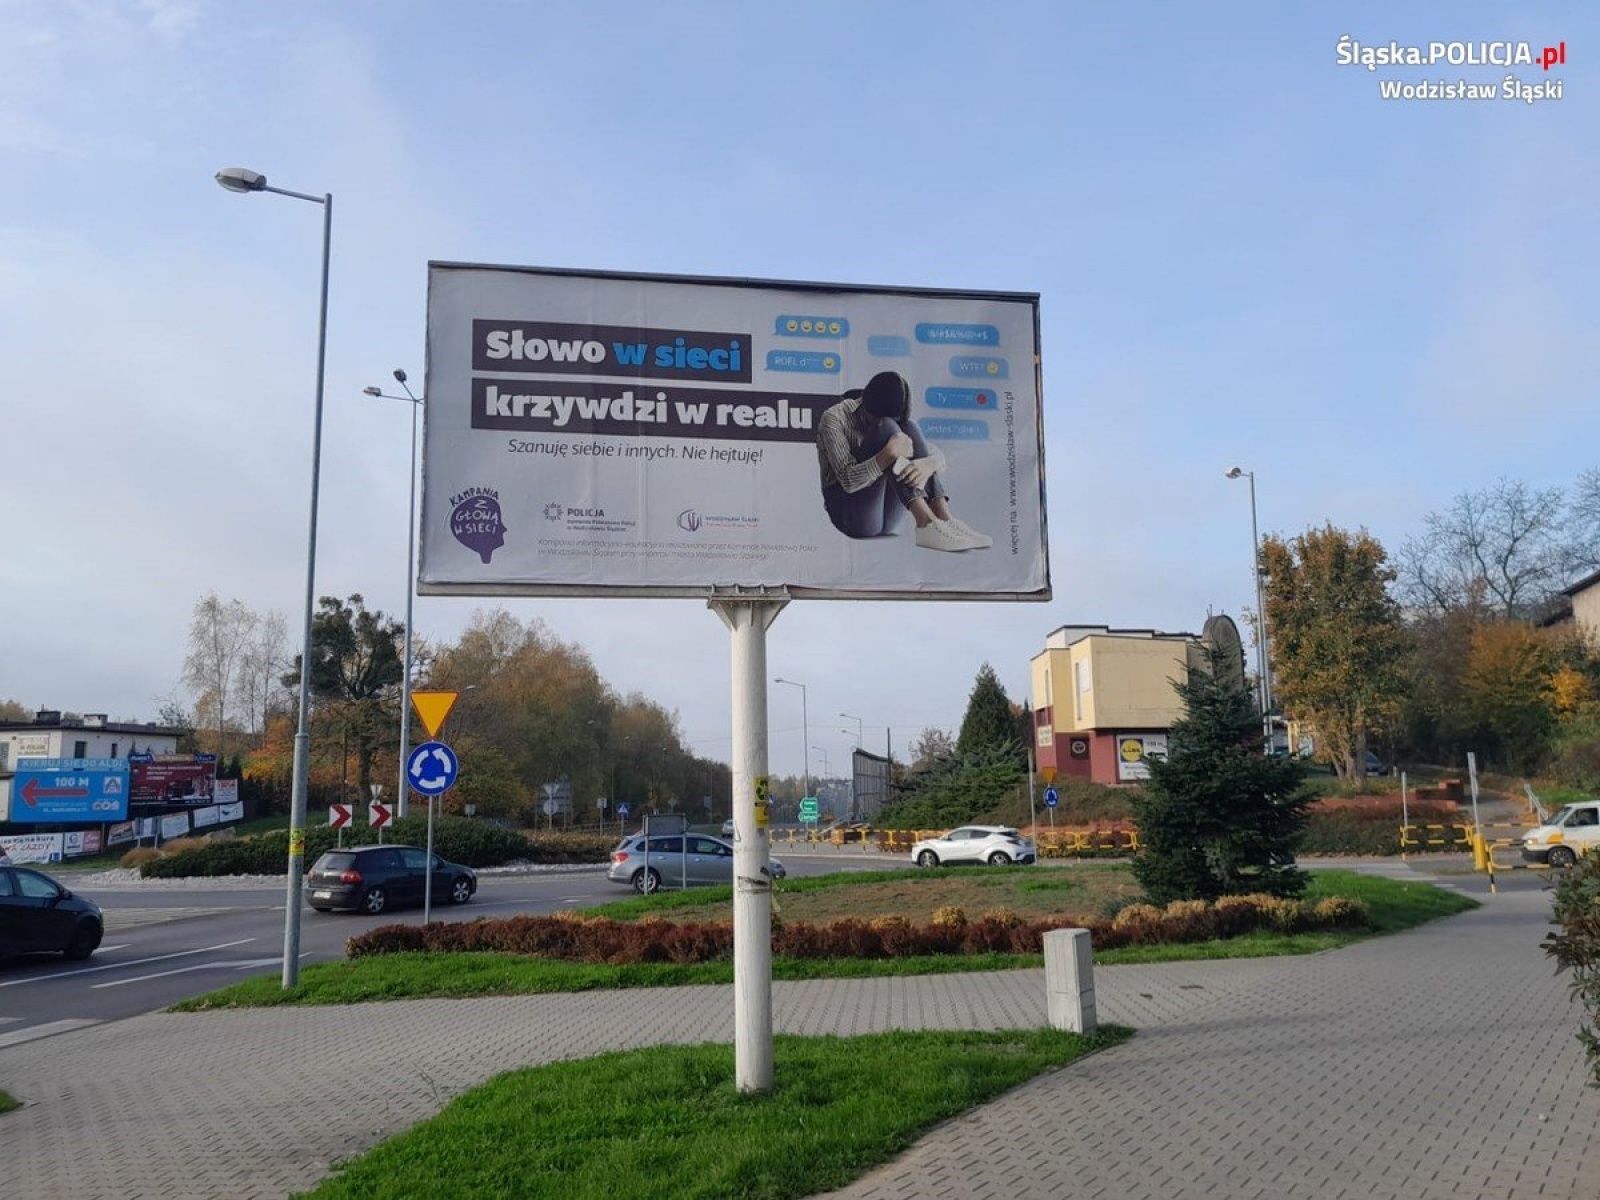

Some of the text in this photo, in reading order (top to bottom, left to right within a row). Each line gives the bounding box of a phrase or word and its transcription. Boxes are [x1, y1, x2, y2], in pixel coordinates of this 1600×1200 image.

[486, 329, 742, 371] Słowo w sieci
[485, 385, 813, 430] krzywdzi w realu
[507, 438, 764, 463] Szanuję siebie i innych. Nie hejtuję!
[449, 486, 499, 507] KAMPANIA
[567, 507, 605, 518] POLICJA
[465, 523, 497, 535] SIECI
[1010, 524, 1019, 556] więcej
[55, 776, 76, 788] 100
